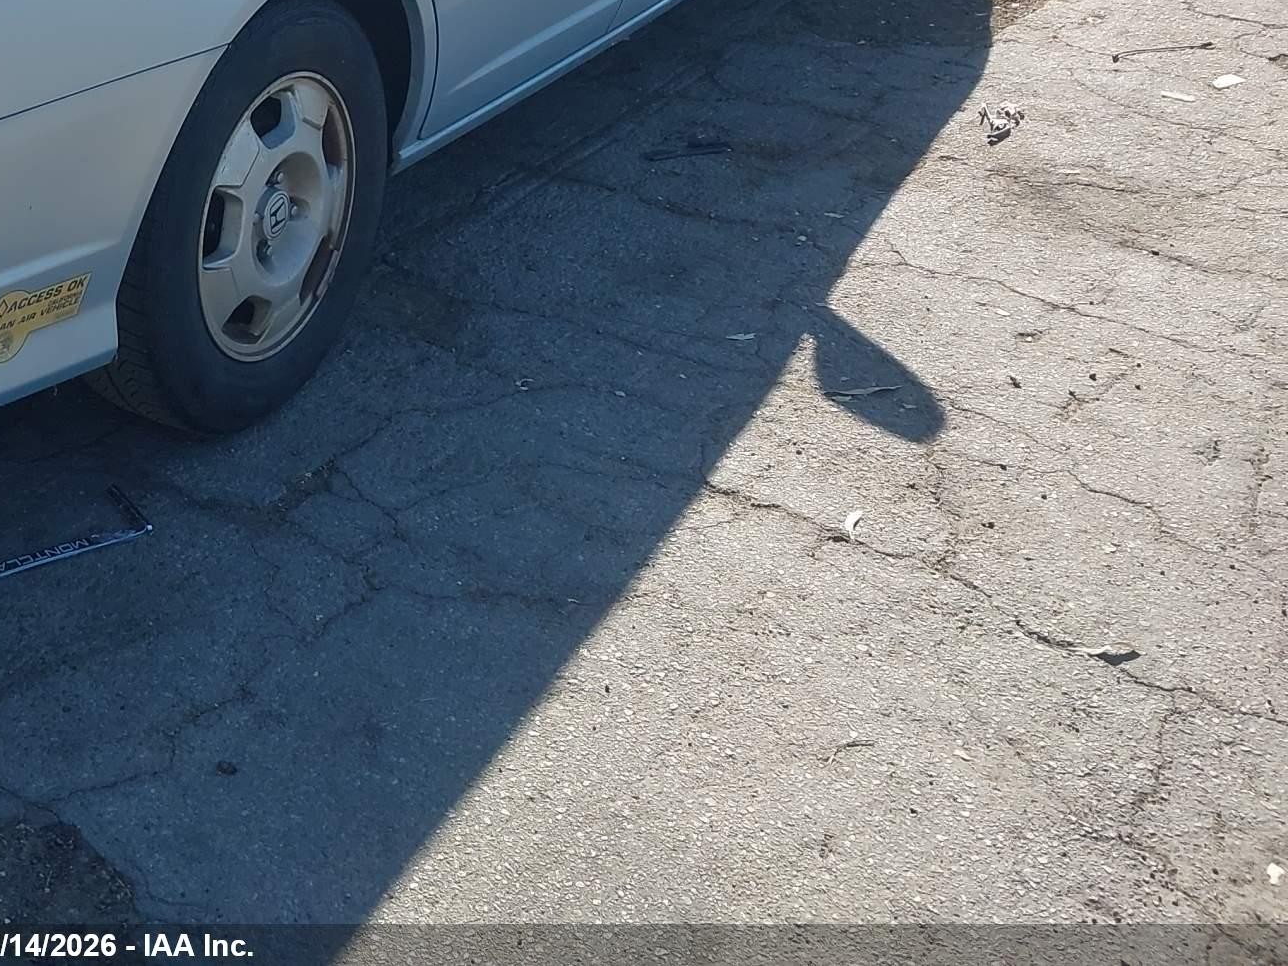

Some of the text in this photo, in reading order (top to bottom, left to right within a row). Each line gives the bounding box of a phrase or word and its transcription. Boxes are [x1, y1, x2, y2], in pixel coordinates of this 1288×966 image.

[7, 285, 63, 314] ACCESS
[67, 277, 87, 292] OK
[18, 312, 36, 325] AIR
